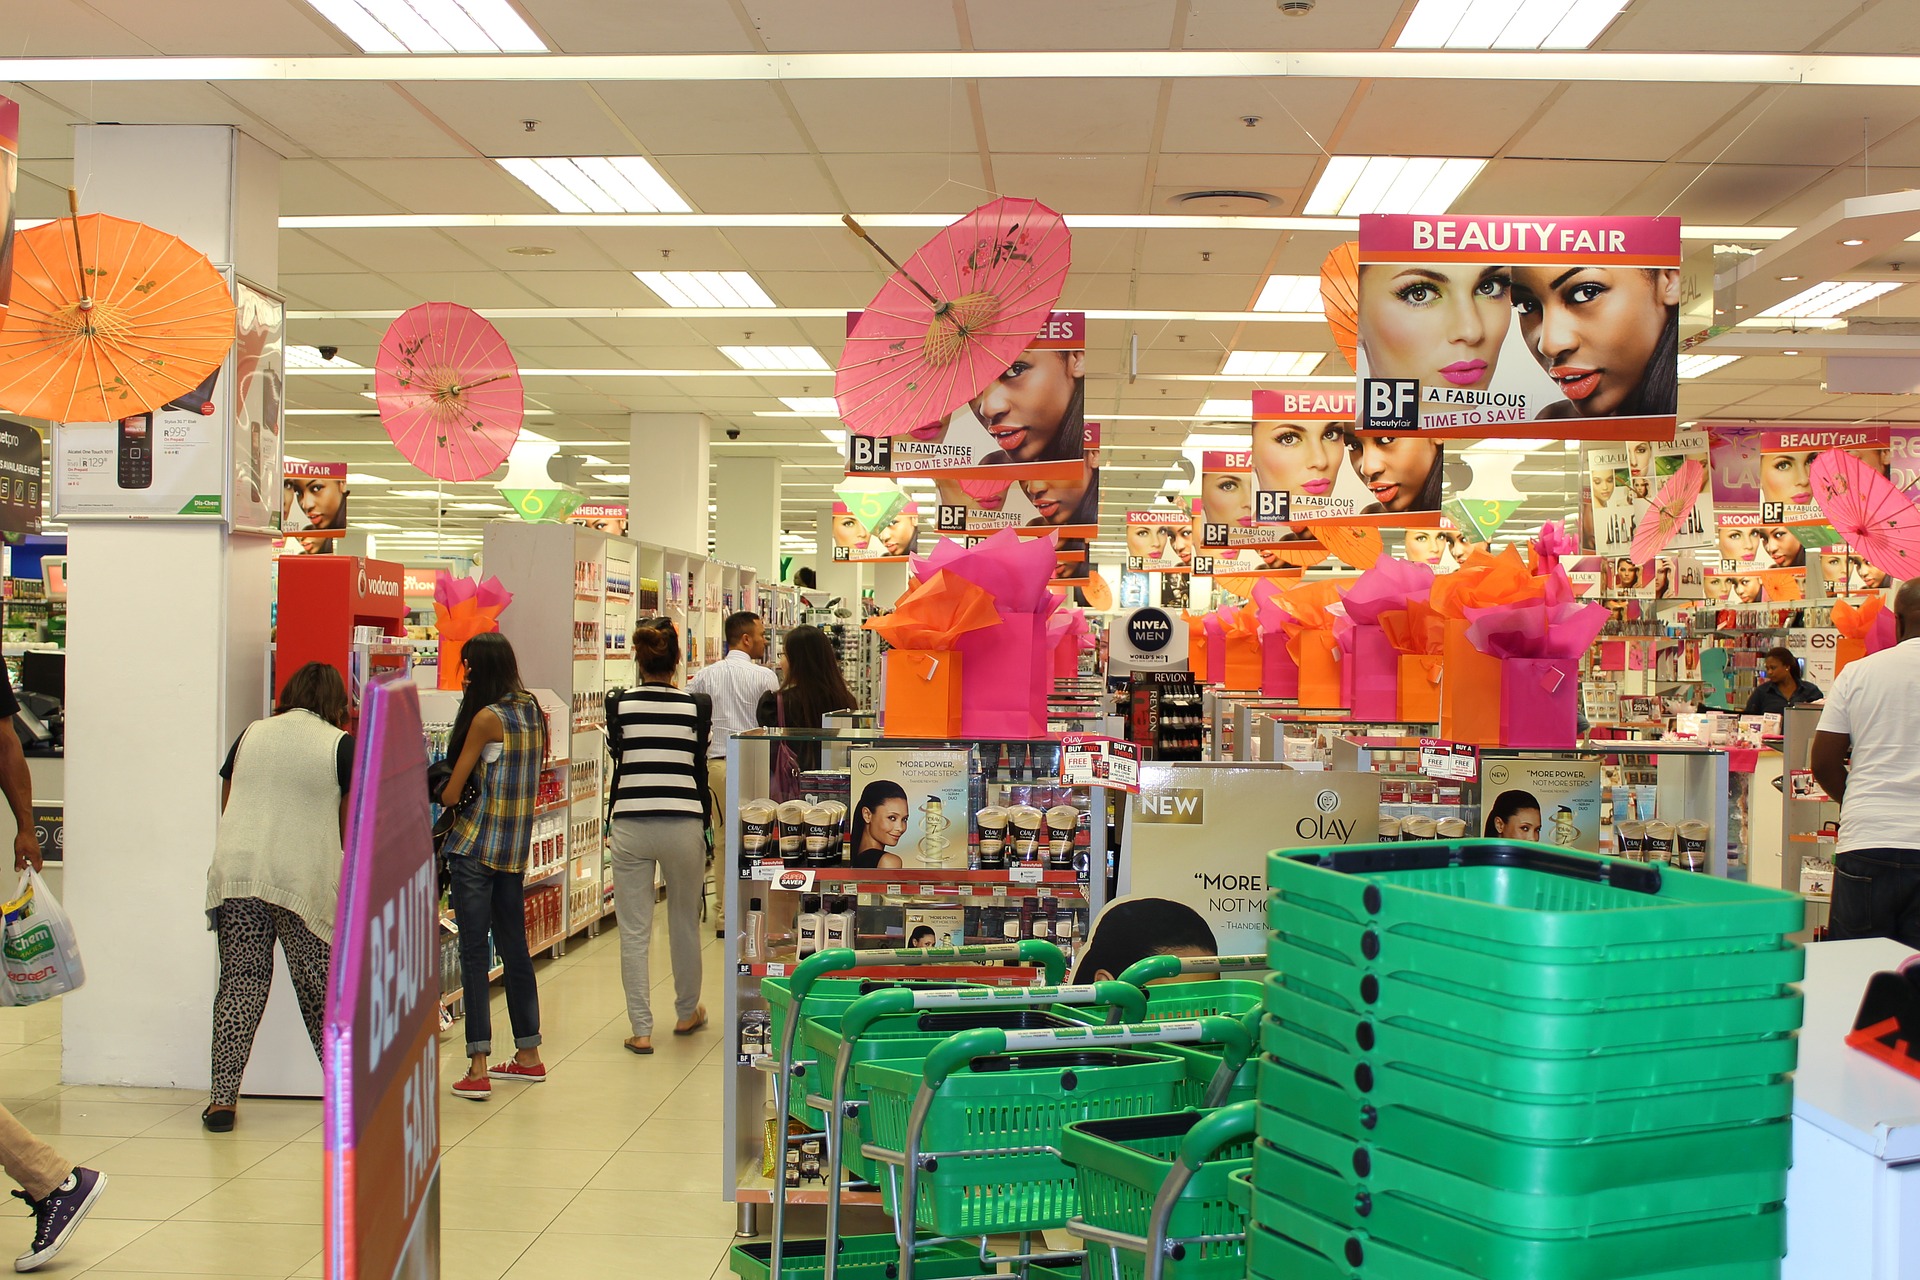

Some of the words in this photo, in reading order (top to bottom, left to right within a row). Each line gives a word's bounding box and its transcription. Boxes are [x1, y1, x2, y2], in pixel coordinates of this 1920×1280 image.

[1412, 221, 1556, 251] BEAUTY
[1560, 230, 1626, 252] FAIR
[1036, 322, 1073, 339] EES
[1284, 395, 1355, 413] BEAUT
[1369, 381, 1416, 418] BF
[1428, 389, 1440, 401] A
[1445, 389, 1526, 408] FABULOUS
[1370, 418, 1411, 429] beautyfair
[1424, 412, 1459, 428] TIME
[1462, 411, 1482, 424] TO
[1487, 408, 1526, 421] SAVE
[1780, 433, 1840, 448] BEAUTY
[1840, 434, 1867, 445] FAIR
[854, 439, 888, 464] BF
[910, 443, 972, 457] FANTASTIESE
[309, 466, 330, 475] FAIR
[855, 464, 886, 472] beautyfair
[895, 459, 912, 471] TYD
[913, 459, 931, 470] OM
[932, 458, 942, 468] TE
[943, 456, 972, 467] SPAAR
[521, 489, 543, 514] 6
[1260, 493, 1287, 515] BF
[1306, 497, 1354, 508] FABULOUS
[604, 508, 622, 516] FEES
[941, 506, 964, 526] BF
[979, 511, 1021, 520] FANTASTIESE
[1130, 513, 1190, 522] SKOONHEIDS
[1293, 512, 1313, 520] TIME
[1316, 510, 1328, 518] TO
[1330, 508, 1354, 516] SAVE
[1479, 500, 1501, 526] 3
[1764, 504, 1782, 519] BF
[1206, 524, 1226, 542] BF
[1240, 528, 1276, 536] FABULOUS
[836, 547, 848, 558] BF
[1130, 556, 1142, 566] BF
[1196, 557, 1212, 571] BF
[1722, 560, 1736, 570] BF
[368, 575, 398, 596] vodacom
[1132, 621, 1168, 630] NIVEA
[1136, 632, 1164, 640] MEN
[1154, 672, 1186, 682] REVLON
[1150, 690, 1158, 732] REVLON
[1114, 743, 1126, 752] BUY
[1114, 750, 1133, 758] THIRD
[1114, 762, 1132, 772] FREE
[1555, 770, 1586, 778] POWER,
[1062, 774, 1073, 784] BF
[1142, 796, 1198, 816] NEW
[1296, 815, 1357, 844] OLAY
[1194, 872, 1262, 891] “MORE
[1209, 898, 1244, 912] NOT
[1226, 920, 1261, 930] THANDIE
[368, 853, 437, 1074] BEAUTY
[403, 1034, 438, 1219] FAIR
